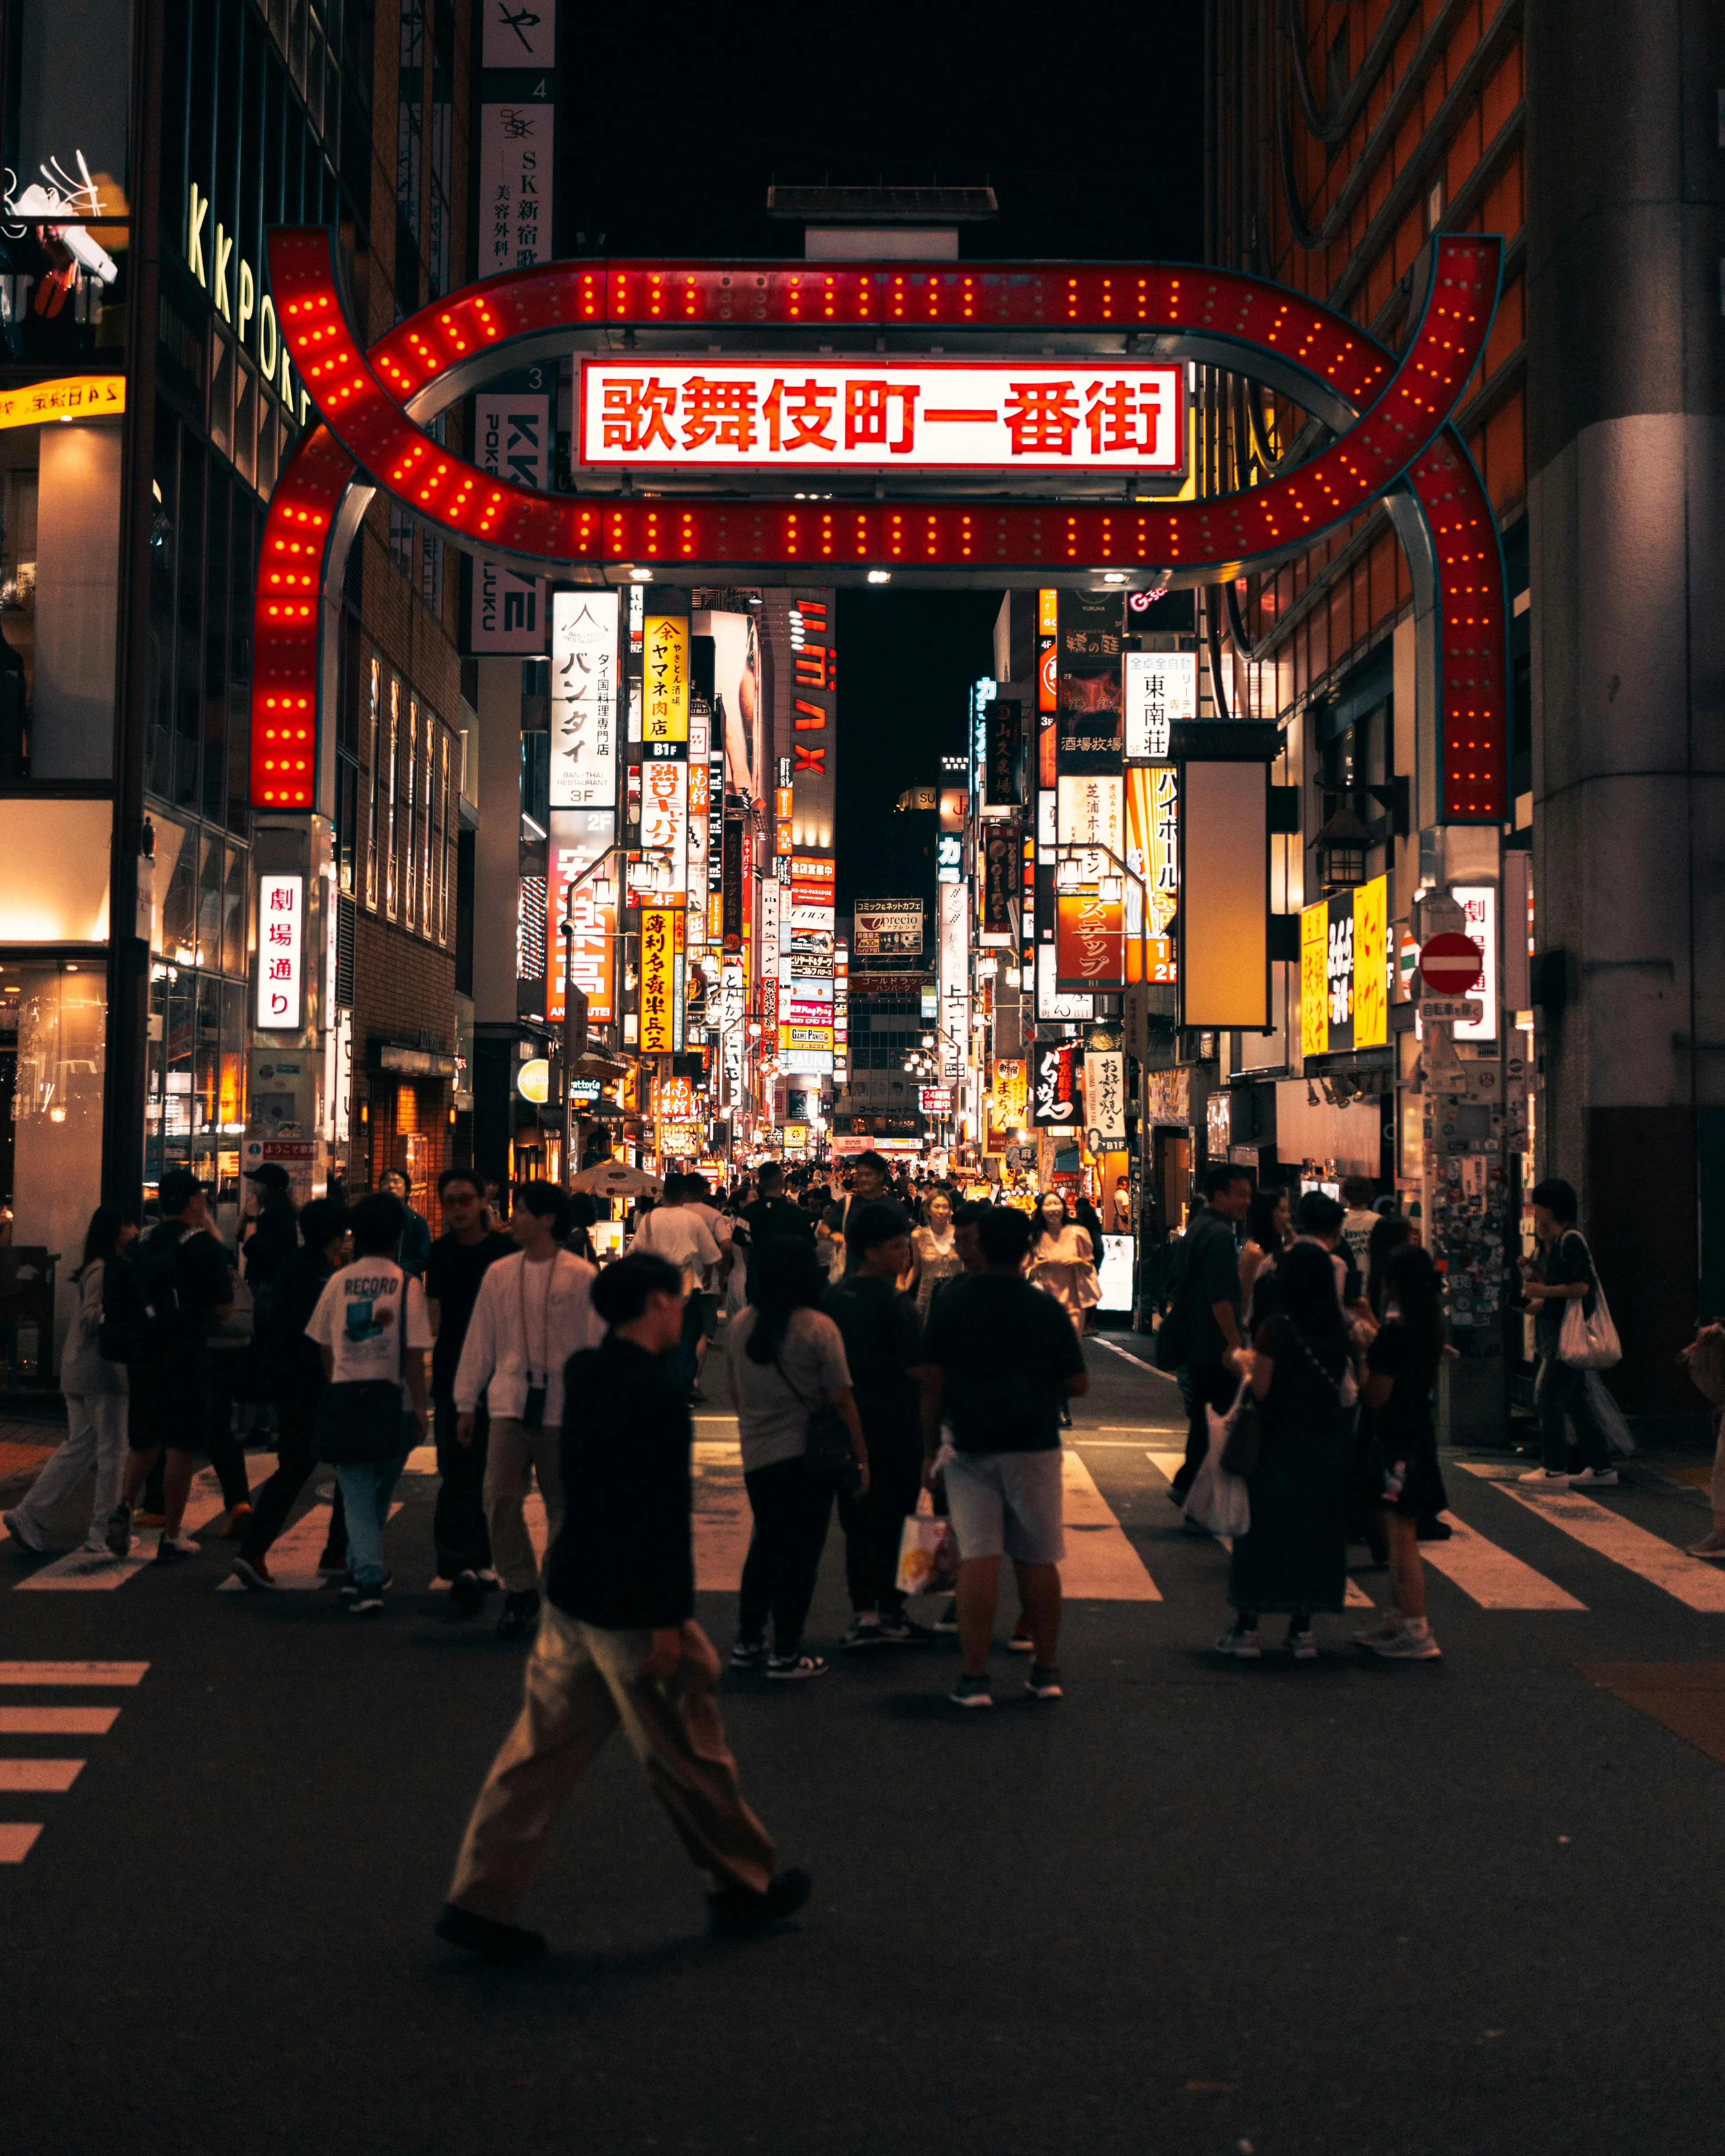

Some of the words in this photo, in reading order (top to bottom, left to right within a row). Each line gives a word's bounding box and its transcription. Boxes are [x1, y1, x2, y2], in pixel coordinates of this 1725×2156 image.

[532, 78, 547, 98] 4
[529, 368, 542, 389] 3
[602, 376, 1161, 455] 歌舞伎町一番街
[1131, 657, 1191, 670] 全卓全自動
[671, 644, 681, 706] やきとん酒場
[794, 586, 837, 775] UMAX
[649, 645, 669, 736] ヤマネ肉店
[560, 652, 591, 764] バンタイ
[597, 653, 610, 756] タイ国料理専門店
[1041, 717, 1053, 726] 3F
[1144, 674, 1166, 755] 東南荘
[654, 743, 677, 756] B1F
[1061, 737, 1123, 752] 酒場牧場
[1129, 745, 1140, 755] 3F
[570, 790, 594, 802] 3F
[588, 814, 612, 831] 2F
[1156, 772, 1177, 889] ハイボール
[791, 862, 833, 876] 全店営業中
[652, 895, 674, 906] 4F
[857, 902, 920, 911] コミック&ネットカフェ
[872, 914, 917, 929] aprecio
[675, 914, 684, 949] 炭火串焼
[1078, 900, 1110, 977] ステップ
[270, 888, 294, 1014] 劇場通り
[1386, 927, 1394, 989] 2F
[550, 1007, 610, 1017] ANUTEI
[1074, 1009, 1092, 1018] B1F
[1423, 1003, 1480, 1017] 自転車を除く
[792, 1028, 807, 1040] GAME
[808, 1030, 823, 1040] PANIC
[788, 1051, 833, 1067] SAUNA
[1000, 1063, 1018, 1074] 新宿
[924, 1090, 951, 1099] 24時間
[1100, 1058, 1122, 1129] お好み焼き
[924, 1100, 951, 1110] 営業中
[998, 1081, 1013, 1127] まっちゃん
[1106, 1142, 1124, 1150] B1F
[345, 1277, 398, 1296] RECORD
